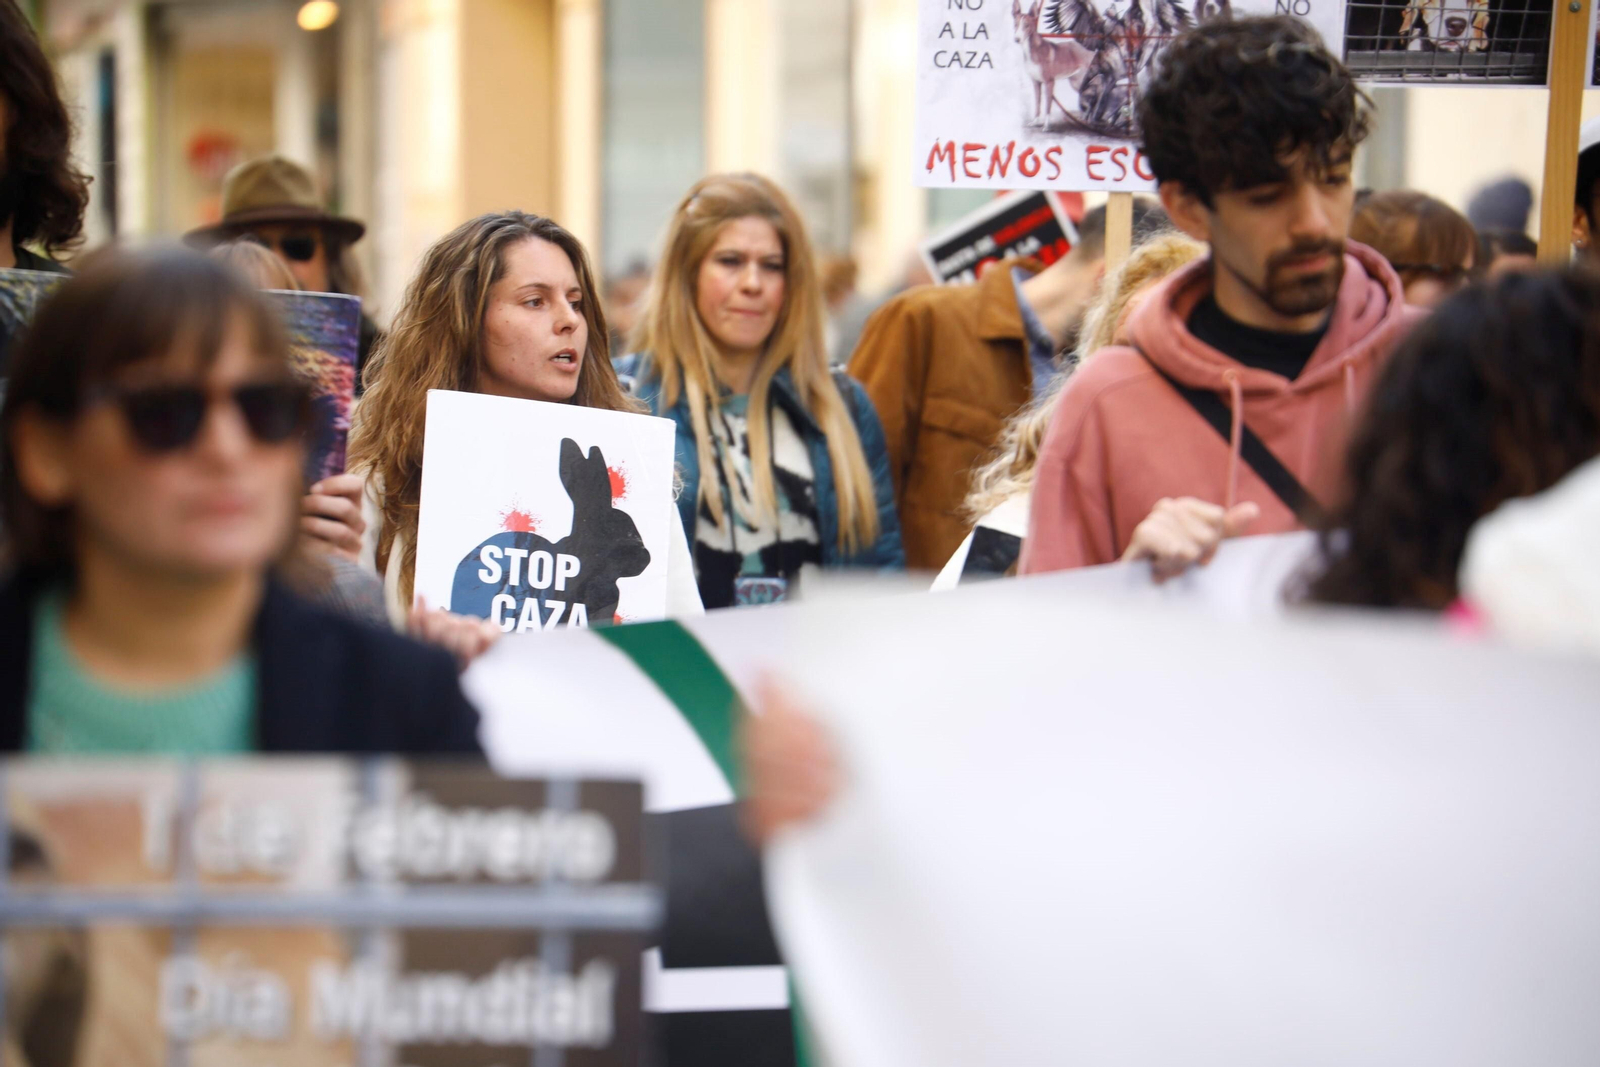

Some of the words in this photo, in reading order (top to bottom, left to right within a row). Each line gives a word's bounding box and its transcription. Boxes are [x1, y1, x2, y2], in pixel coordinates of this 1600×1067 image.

[948, 0, 984, 11] NO
[1275, 0, 1311, 16] NO
[938, 21, 955, 39] A
[962, 22, 989, 40] LA
[933, 50, 994, 69] CAZA
[925, 139, 1063, 182] MENOS
[478, 545, 581, 591] STOP
[490, 593, 589, 633] CAZA
[328, 792, 616, 880] Febrero
[308, 957, 615, 1047] Mundial
